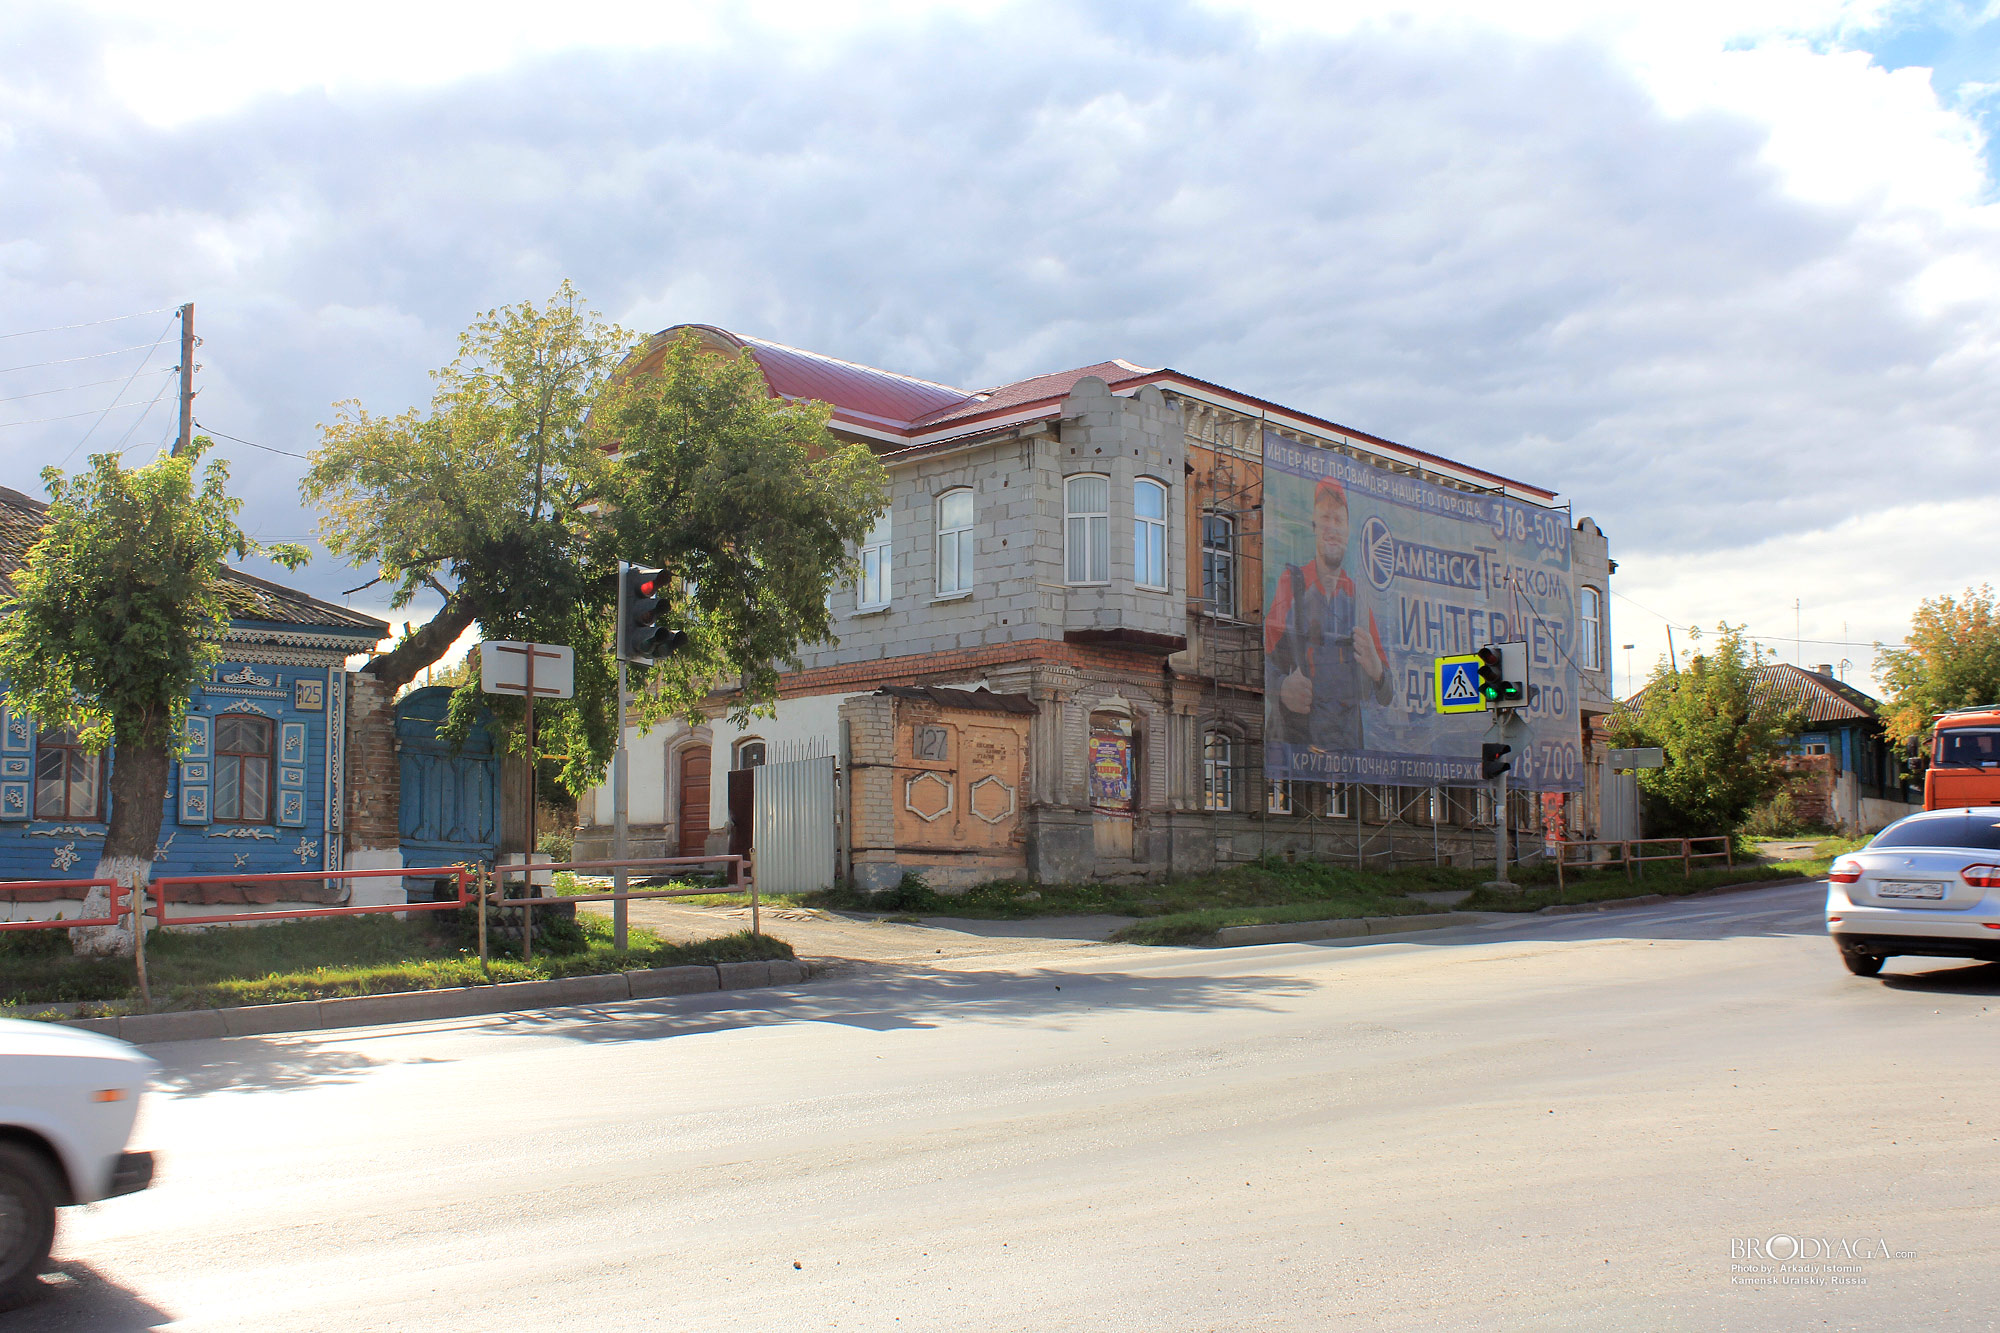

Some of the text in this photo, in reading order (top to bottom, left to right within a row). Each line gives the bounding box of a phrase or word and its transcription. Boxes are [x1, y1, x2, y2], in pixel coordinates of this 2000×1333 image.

[1266, 442, 1483, 518] ИНТЕРНЕТ ПРОВАЙДЕР НАШЕГО ГОРОДА
[1491, 503, 1566, 550] 378-500
[1401, 597, 1563, 665] ИНТЕРНЕТ
[300, 685, 321, 703] 125
[919, 728, 947, 759] 127
[1293, 753, 1482, 780] КРУГЛОСУТОЧНАЯ ТЕХПОДДЕРЖК
